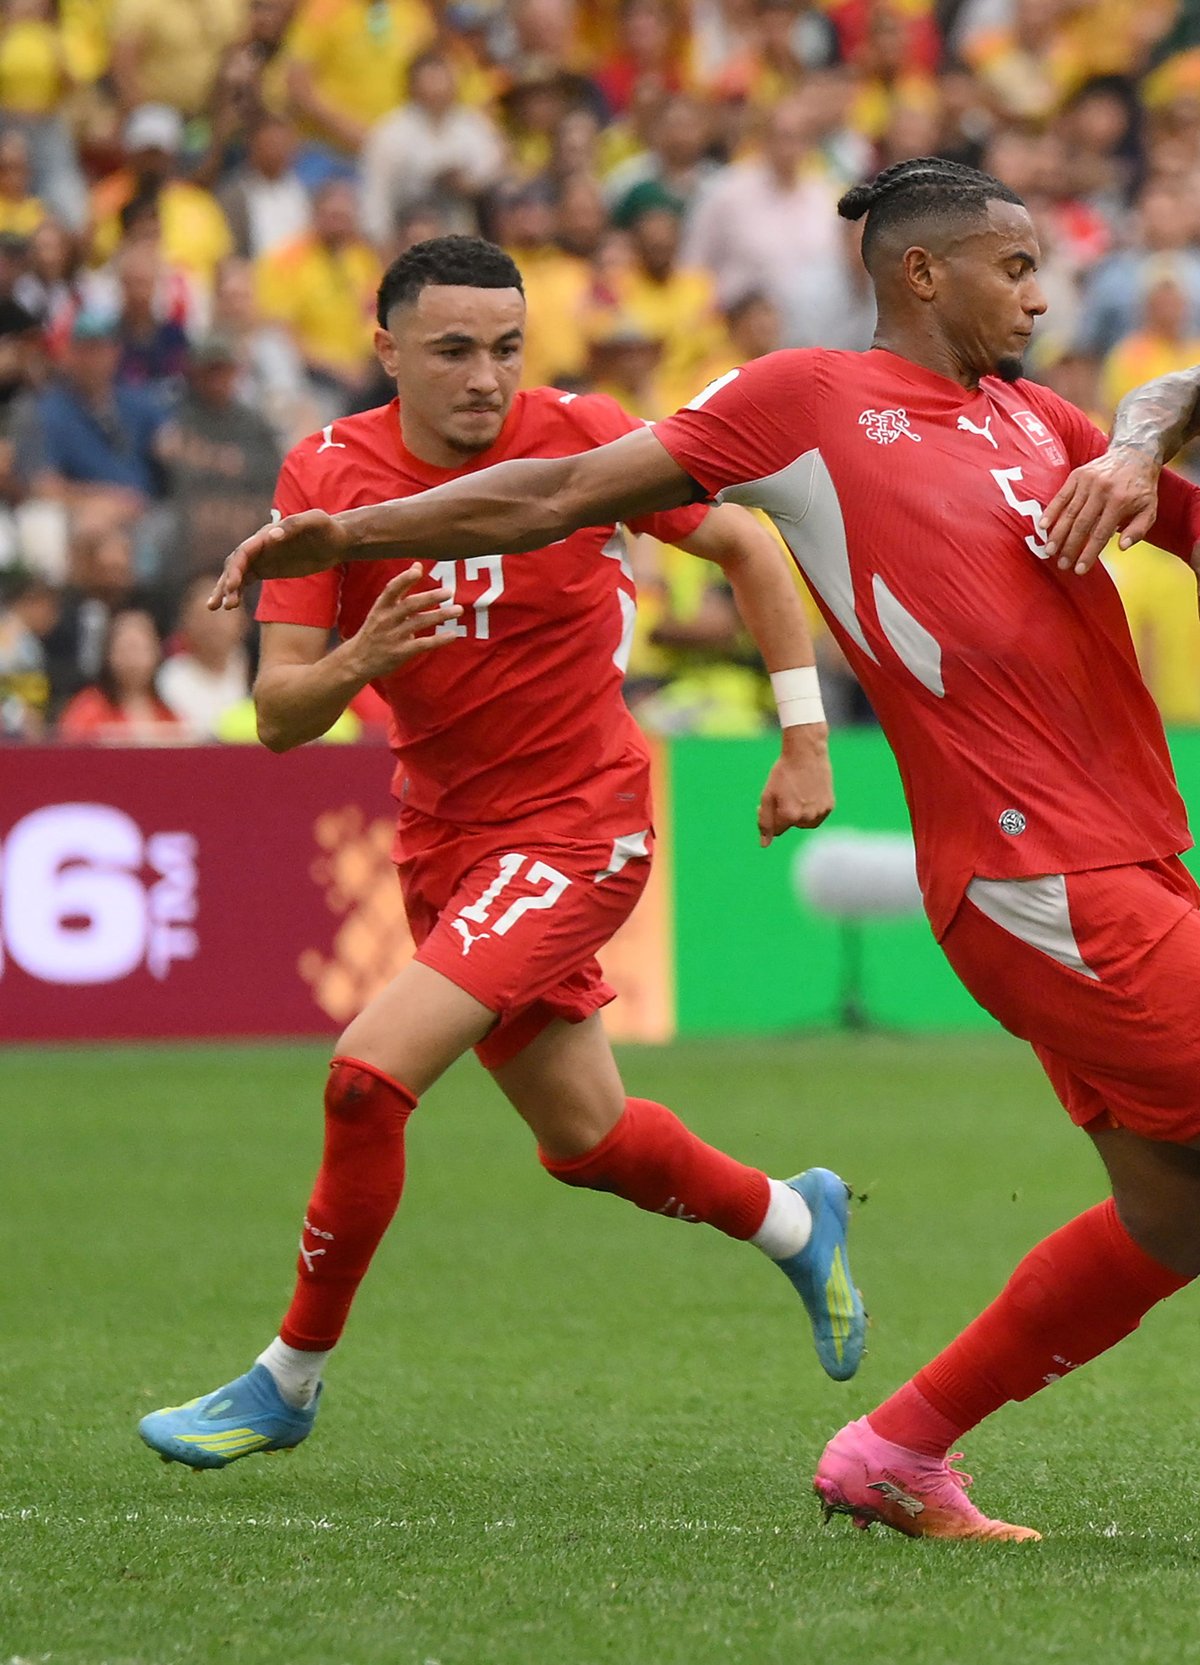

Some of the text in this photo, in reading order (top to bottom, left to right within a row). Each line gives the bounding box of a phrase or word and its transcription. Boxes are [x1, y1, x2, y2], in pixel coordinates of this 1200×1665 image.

[989, 466, 1051, 560] 5
[429, 554, 505, 640] 17
[0, 801, 147, 985] 6
[459, 852, 573, 936] 17
